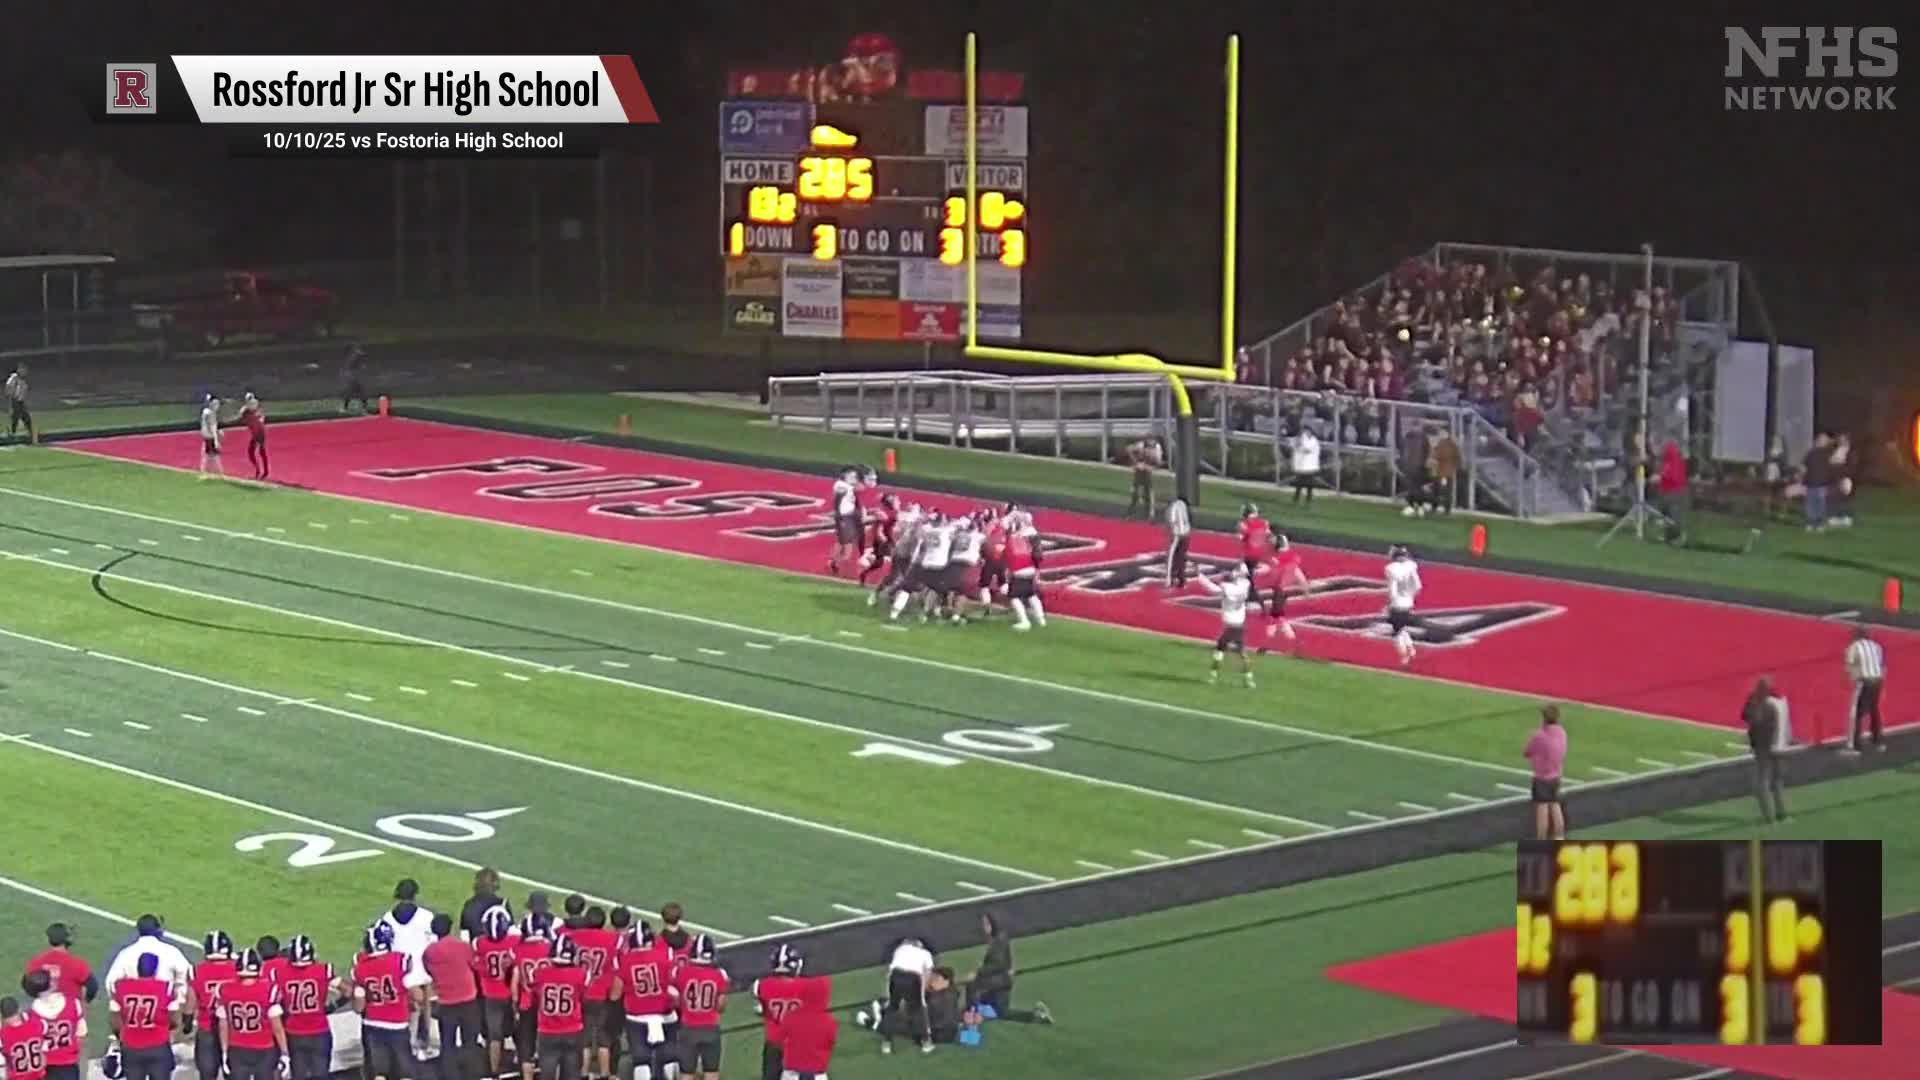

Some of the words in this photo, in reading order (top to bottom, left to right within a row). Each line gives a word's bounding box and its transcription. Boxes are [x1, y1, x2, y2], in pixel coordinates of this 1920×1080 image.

[729, 163, 790, 180] HOME
[745, 227, 793, 249] DOWN
[812, 223, 837, 260] 3
[839, 229, 859, 250] TO
[866, 229, 890, 252] GO
[900, 230, 924, 252] ON
[939, 228, 964, 265] 3
[999, 231, 1025, 267] 3
[849, 728, 1056, 767] 10
[234, 813, 496, 868] 20
[286, 979, 318, 1013] 72
[631, 962, 662, 996] 51
[684, 979, 717, 1012] 40
[123, 995, 158, 1029] 77
[542, 983, 574, 1016] 66
[229, 1001, 262, 1033] 62
[10, 1037, 44, 1075] 26
